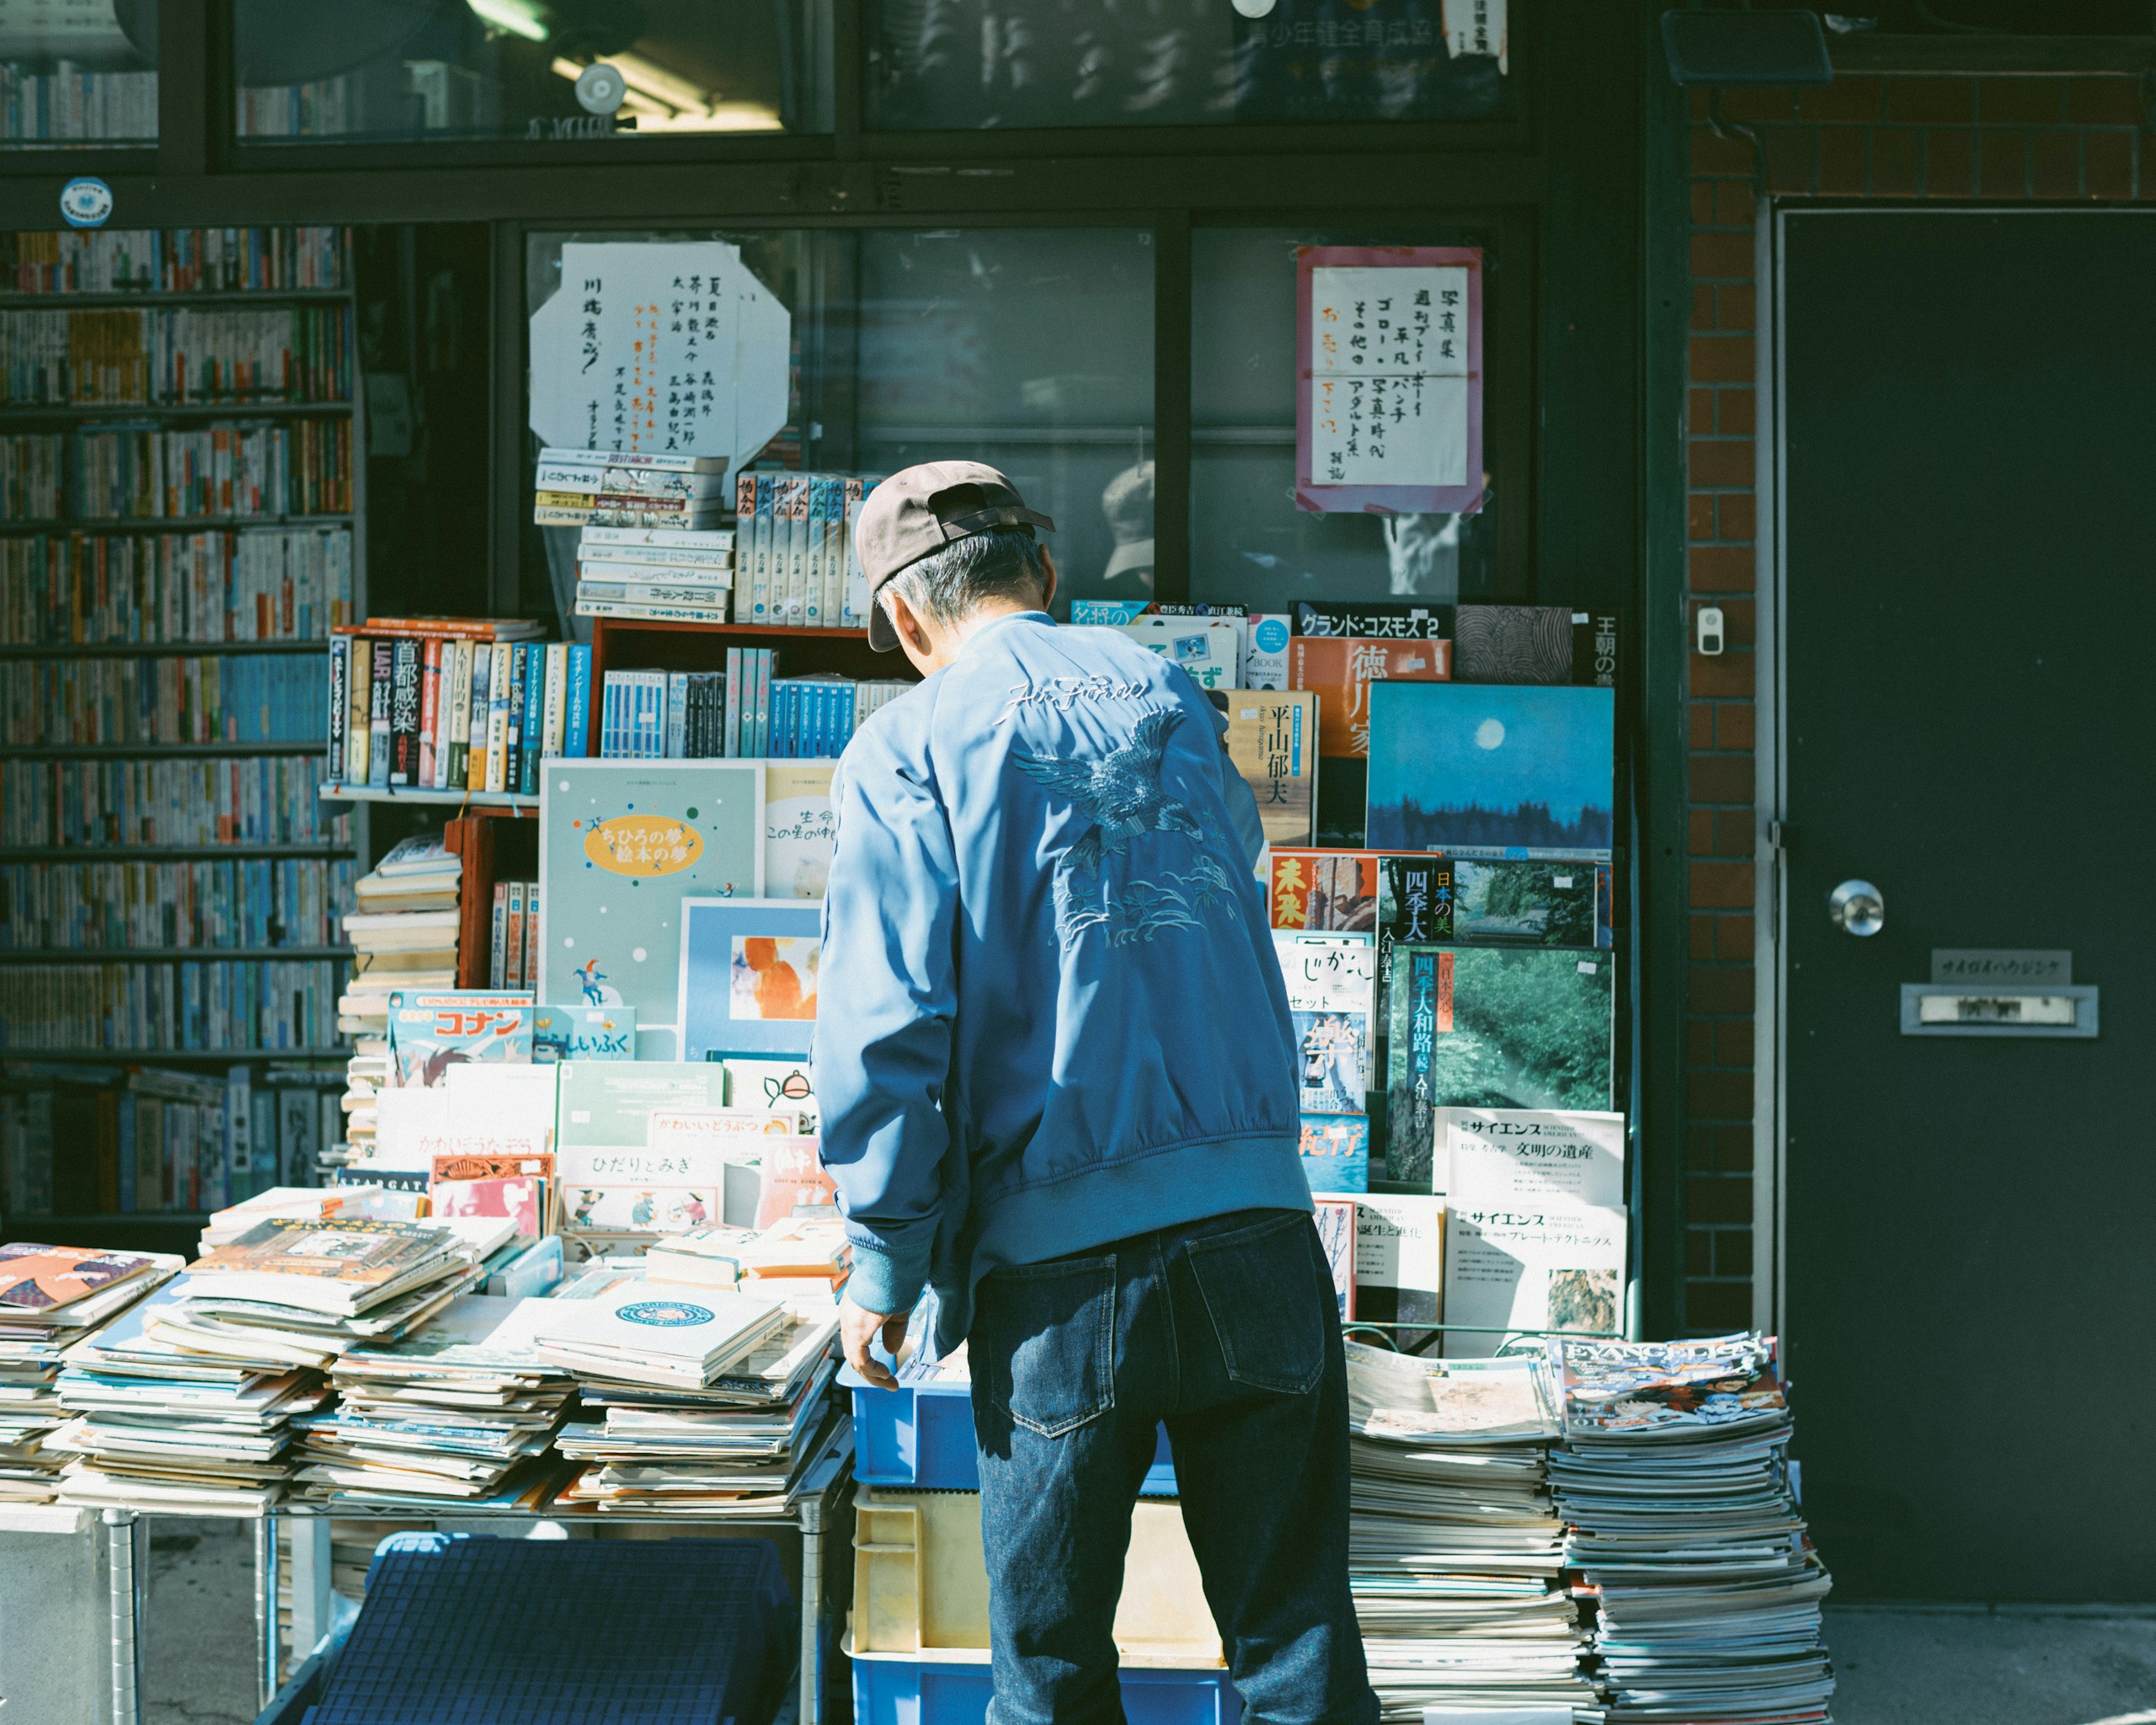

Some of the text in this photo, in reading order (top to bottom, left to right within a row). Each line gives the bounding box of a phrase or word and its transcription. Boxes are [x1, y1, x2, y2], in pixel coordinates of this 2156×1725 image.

[1438, 290, 1460, 359] 写真集
[547, 471, 599, 485] 小林よしのり
[547, 510, 588, 521] 小林よしのり
[649, 588, 717, 604] 朝日殺人事件
[1072, 606, 1130, 626] 名将の
[1160, 604, 1245, 617] 豊臣秀吉 直江兼続
[1301, 614, 1422, 638] グランド・コスモス
[1426, 617, 1439, 639] 2
[373, 641, 392, 681] LIAR
[1253, 659, 1283, 668] BOOK
[455, 646, 467, 702] 人生の目的
[392, 638, 419, 735] 首都感染
[1348, 644, 1389, 756] 徳川家
[1265, 705, 1291, 804] 平山郁夫
[800, 810, 834, 825] 生命
[600, 828, 683, 846] ちひろの夢
[616, 846, 689, 863] 絵本の夢
[1273, 857, 1309, 925] 未来
[1403, 870, 1428, 942] 四季大
[1433, 871, 1453, 935] 日本の美
[1438, 968, 1453, 1014] 日本の心
[1412, 956, 1434, 1054] 四季大和路
[435, 1011, 521, 1038] コナン
[1416, 1055, 1428, 1071] 続
[1414, 1073, 1428, 1130] 入江泰吉
[659, 1118, 758, 1133] かわいいどうぶつ
[1470, 1122, 1542, 1136] サイエンス
[1516, 1141, 1594, 1160] 文明の遺産
[591, 1156, 692, 1174] ひだりとみぎ
[1470, 1211, 1545, 1226] サイエンス
[1510, 1231, 1612, 1247] プレート・テクトニクス
[1566, 1331, 1762, 1364] EVANGELION
